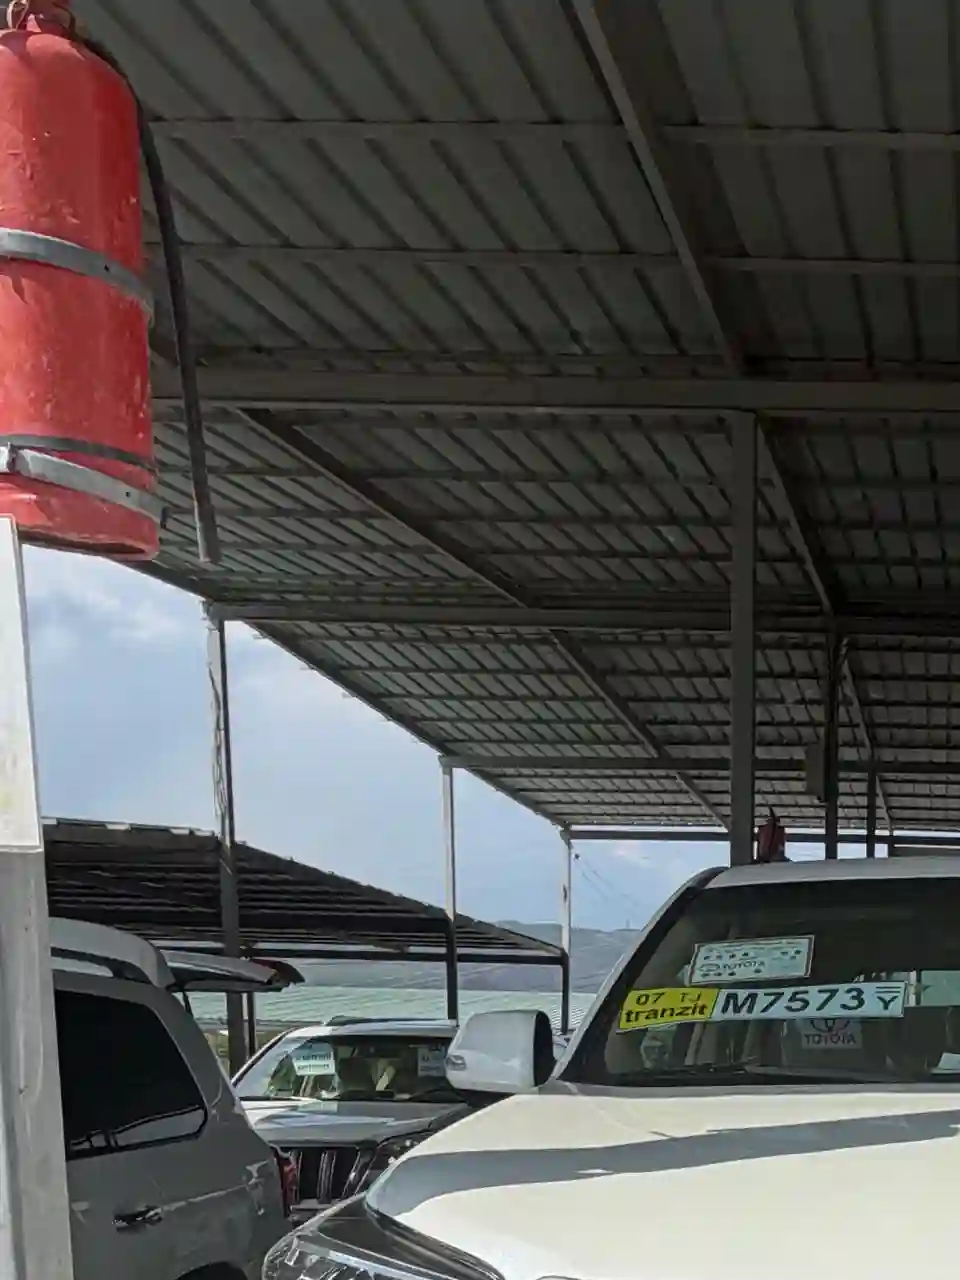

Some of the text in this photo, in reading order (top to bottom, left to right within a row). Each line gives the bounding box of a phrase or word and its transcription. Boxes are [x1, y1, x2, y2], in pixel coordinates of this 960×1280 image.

[636, 992, 664, 1006] 07
[721, 987, 866, 1014] M7573
[625, 1003, 708, 1024] tranzit
[803, 1032, 857, 1046] TOYOTA
